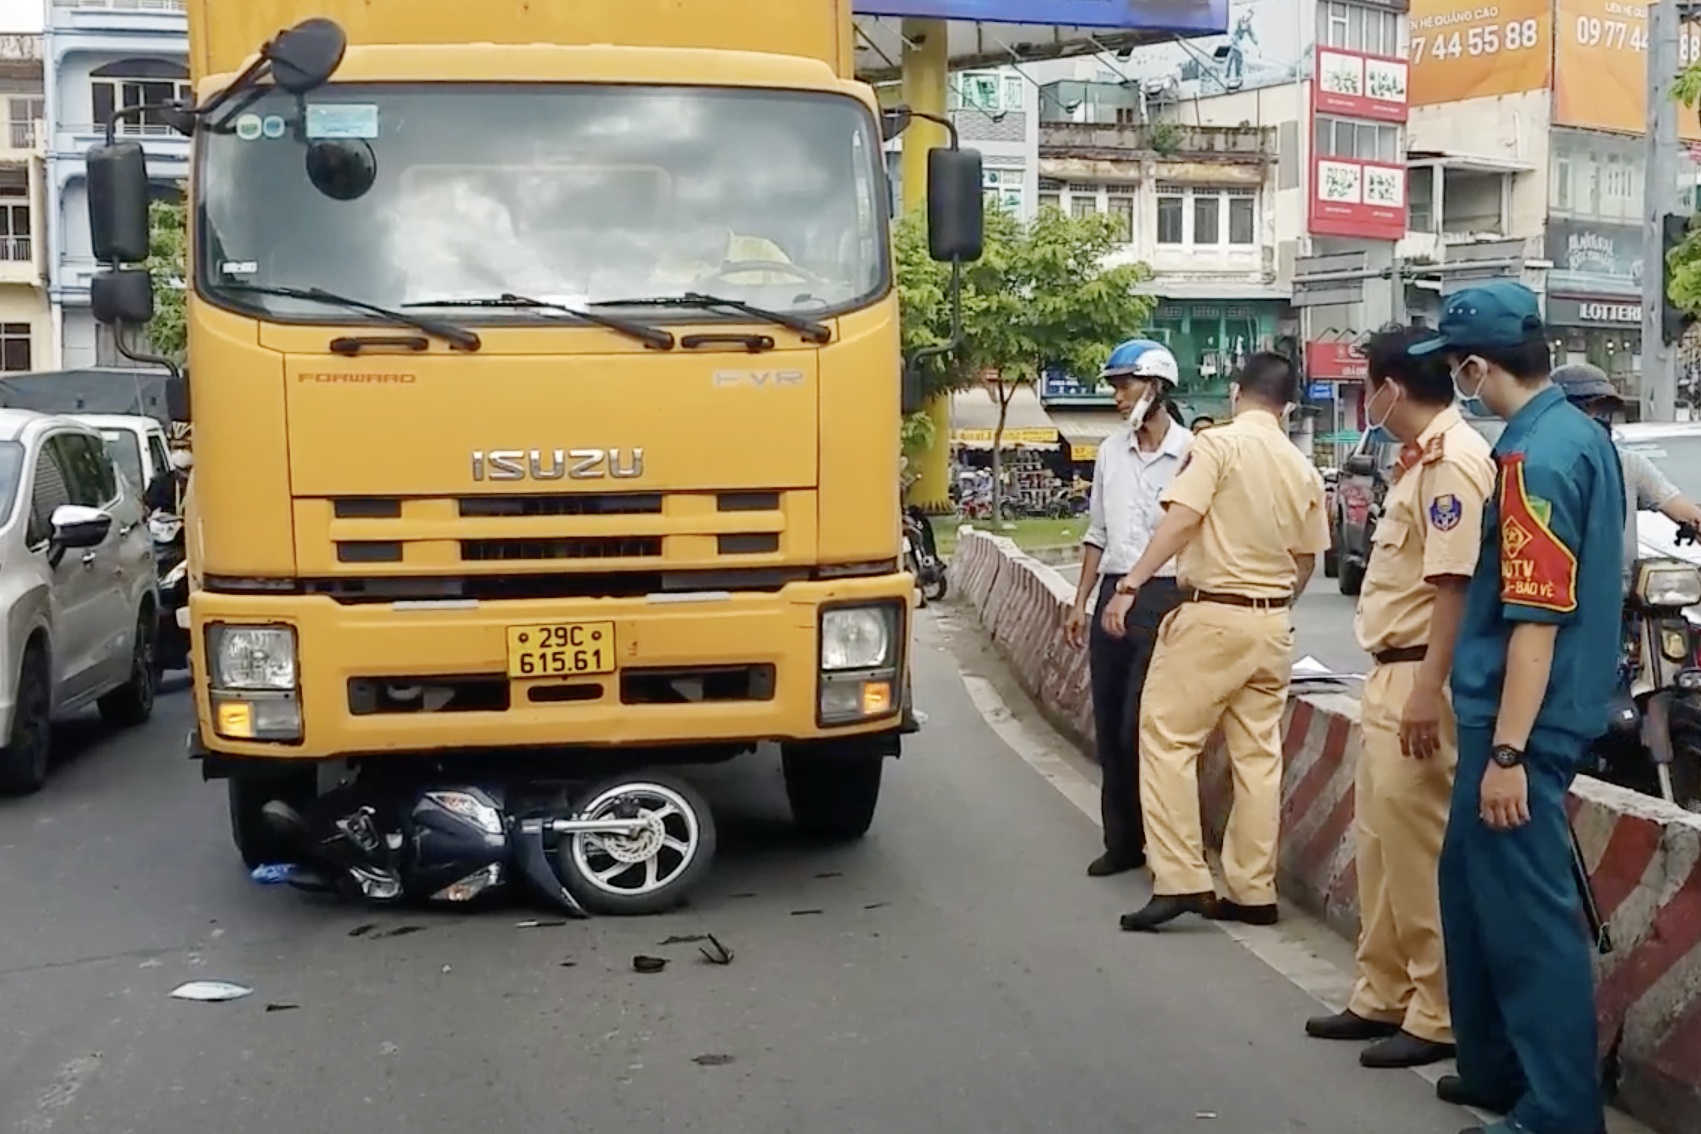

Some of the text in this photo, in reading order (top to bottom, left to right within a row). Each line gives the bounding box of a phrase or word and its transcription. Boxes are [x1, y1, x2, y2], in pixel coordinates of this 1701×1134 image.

[1431, 33, 1462, 60] 44
[1467, 25, 1500, 56] 55
[1505, 19, 1538, 49] 88
[1577, 16, 1601, 46] 09
[1604, 20, 1627, 49] 77
[298, 369, 805, 388] FORWARD FVR
[472, 448, 644, 482] ISUZU
[538, 625, 584, 649] 29C
[520, 649, 602, 674] 615.61
